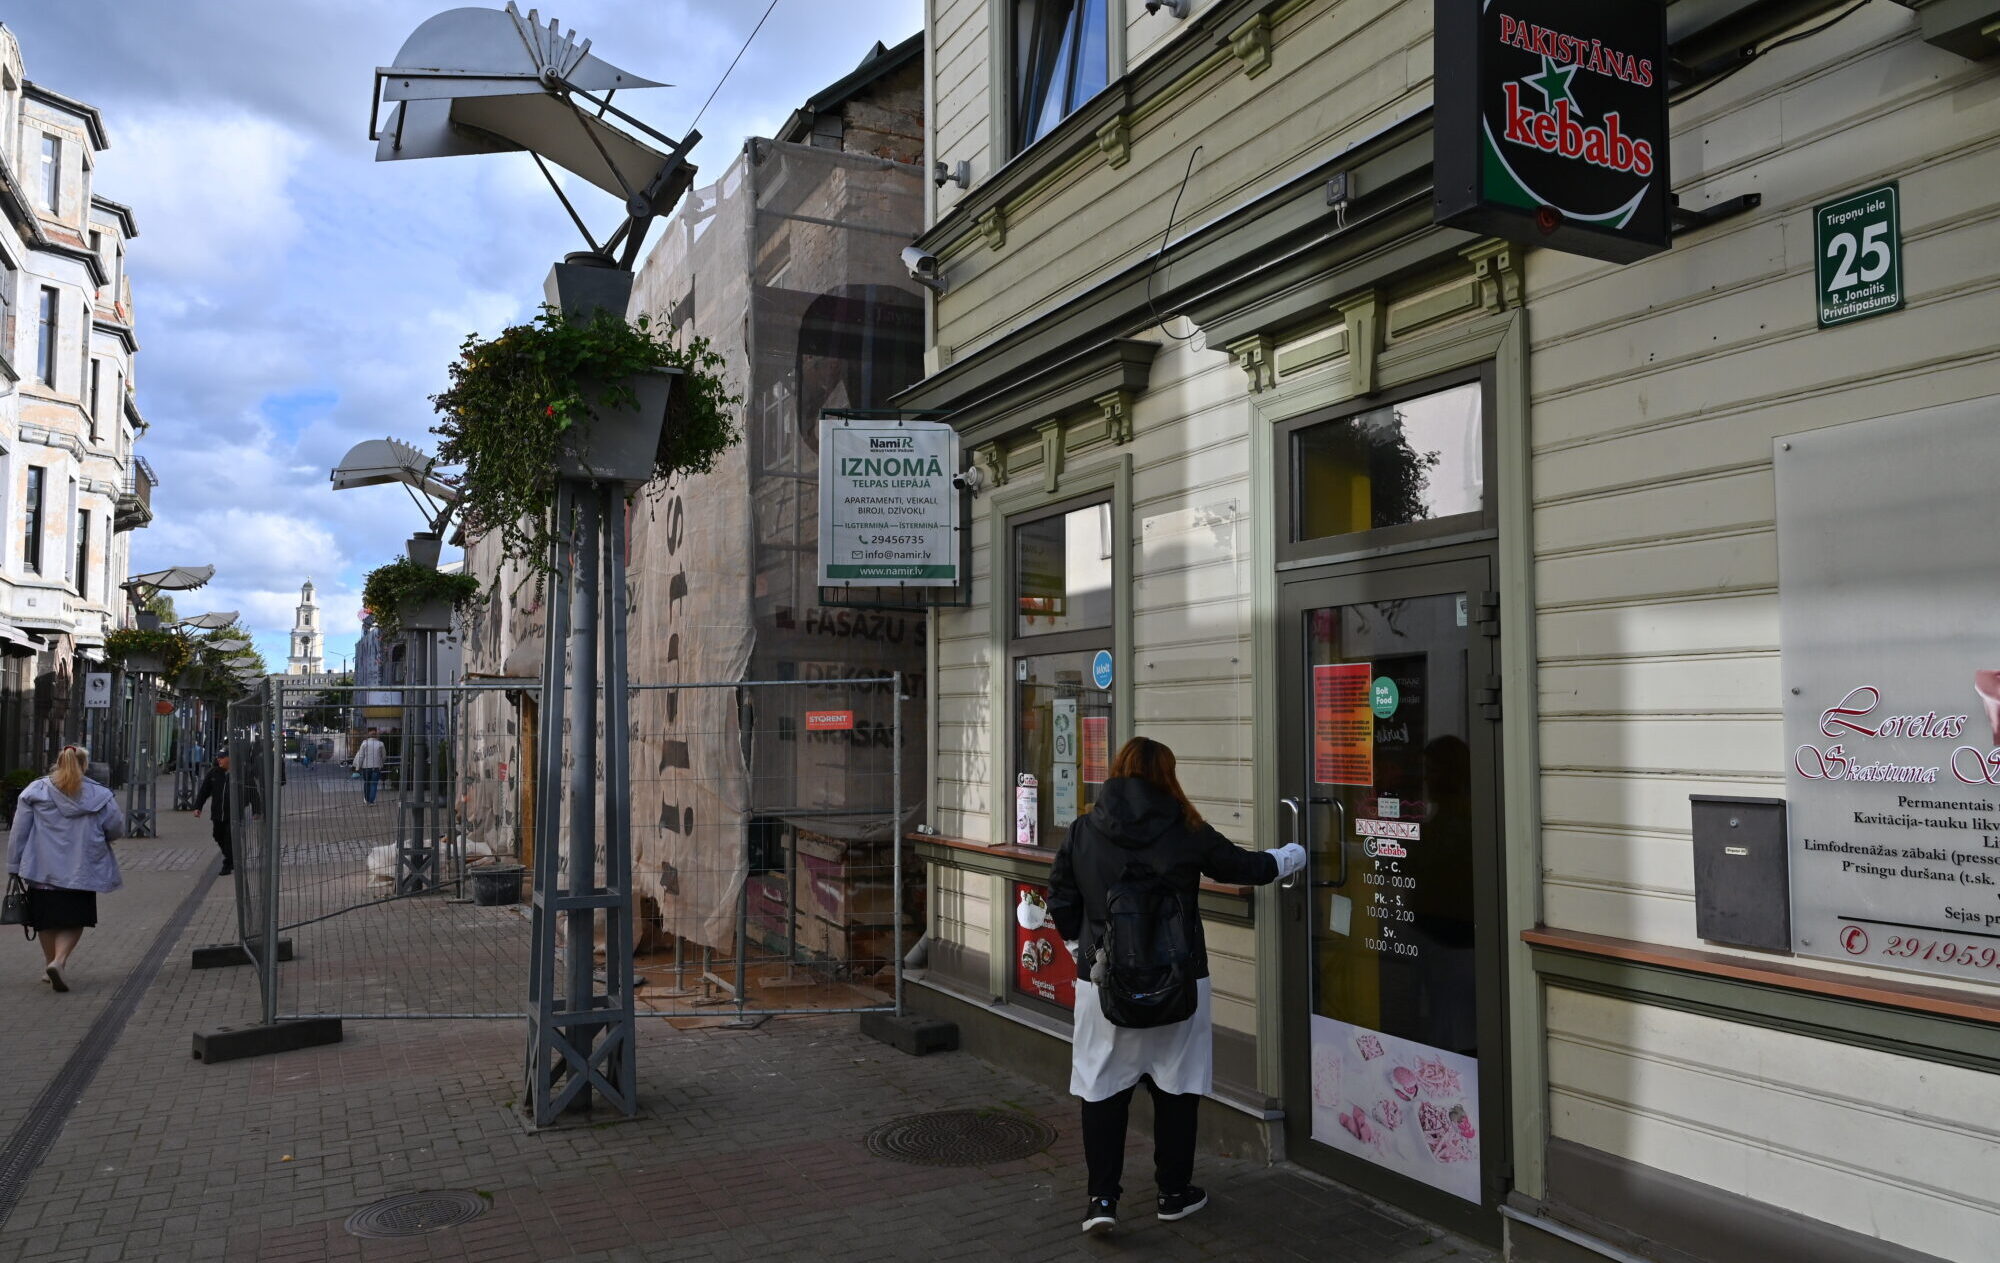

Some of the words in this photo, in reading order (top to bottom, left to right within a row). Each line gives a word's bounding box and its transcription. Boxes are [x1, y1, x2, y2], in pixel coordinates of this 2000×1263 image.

[1500, 14, 1653, 87] PAKISTĀNAS
[1503, 82, 1653, 176] kebabs
[1827, 207, 1864, 226] Tirgoņu
[1867, 200, 1886, 214] iela
[1827, 221, 1891, 292] 25
[1832, 293, 1842, 305] R.
[1845, 282, 1885, 302] Jonaitis
[841, 455, 943, 477] IZNOMĀ
[853, 480, 889, 488] TELPAS
[891, 478, 931, 488] LIEPĀJĀ
[871, 535, 924, 544] 29456735
[865, 550, 932, 560] info@namir.lv
[859, 567, 924, 576] www.namir.lv
[1376, 696, 1393, 705] Food
[1820, 686, 1967, 738] Loretas
[1794, 744, 1939, 783] Skaistuma
[1898, 795, 1994, 812] Permanentais
[1853, 812, 1967, 829] Kavitācija-tauku
[1803, 839, 1898, 857] Limfodrenāžas
[1901, 848, 1946, 861] zābaki
[1983, 835, 2000, 848] Li
[1375, 860, 1383, 871] P.
[1391, 862, 1401, 873] C.
[1363, 873, 1385, 886] 10.00
[1392, 876, 1416, 889] 00.00
[1900, 865, 1955, 881] duršana
[1960, 871, 1995, 886] (t.sk.
[1396, 895, 1404, 907] S.
[1367, 906, 1388, 918] 10.00
[1395, 909, 1415, 922] 2.00
[1944, 906, 1981, 924] Sejas
[1383, 926, 1397, 938] Sv.
[1365, 938, 1387, 951] 10.00
[1394, 942, 1418, 957] 00.00
[1882, 935, 2000, 971] 291959
